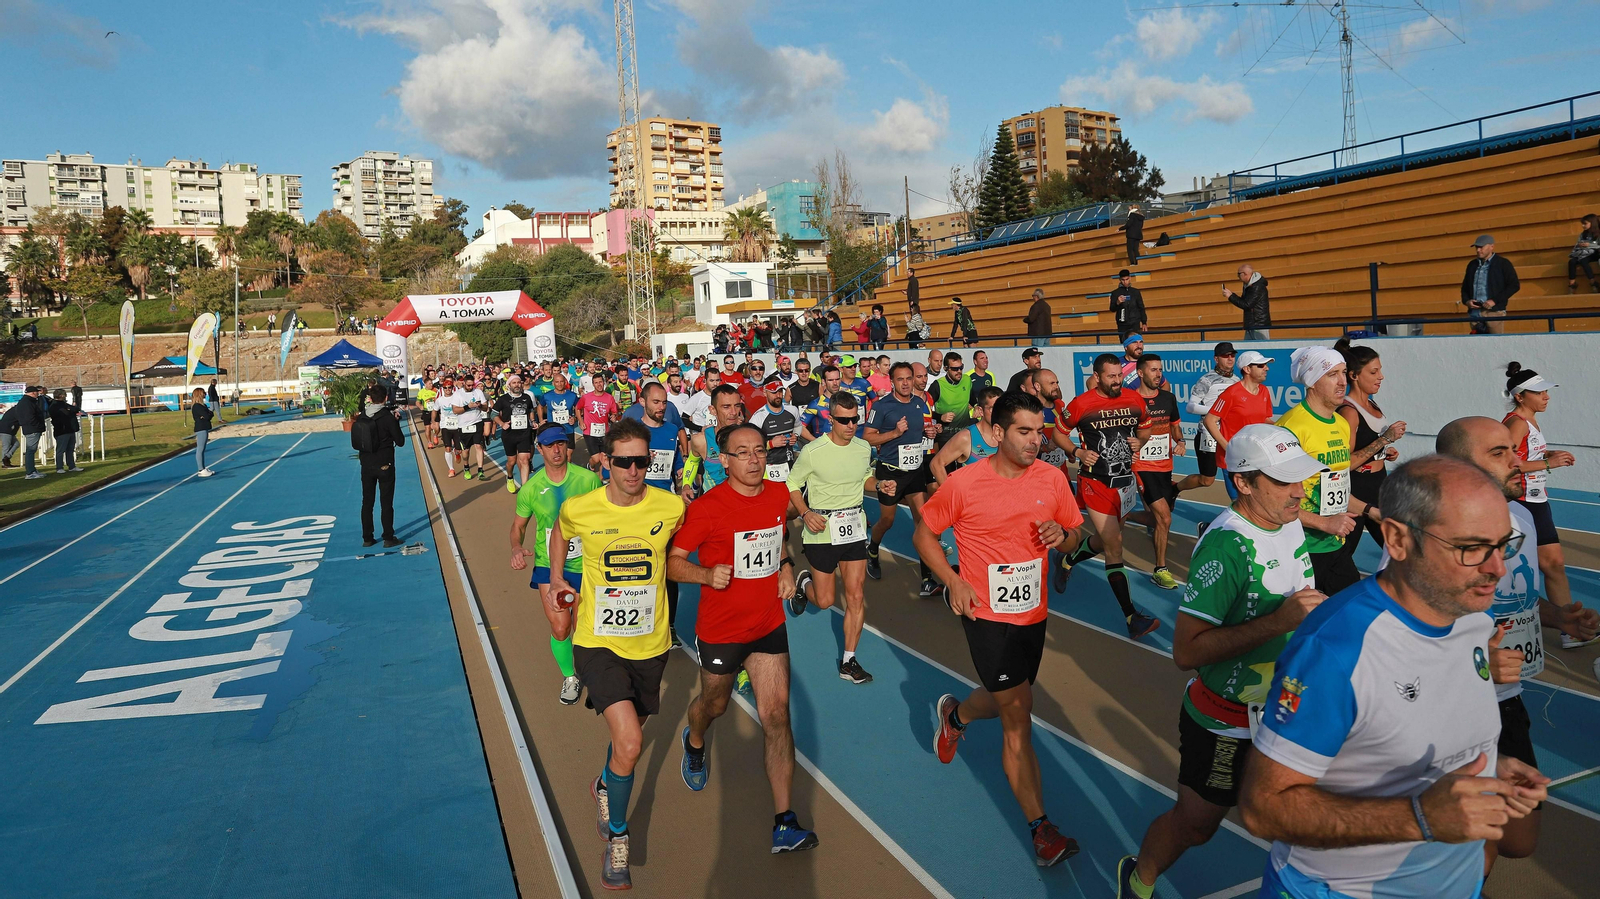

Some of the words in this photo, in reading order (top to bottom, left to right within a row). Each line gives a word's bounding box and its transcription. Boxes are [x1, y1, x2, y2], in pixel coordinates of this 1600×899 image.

[438, 296, 494, 307] TOYOTA
[439, 310, 450, 319] A.
[452, 308, 495, 318] TOMAX
[1098, 407, 1131, 419] TEAM
[1090, 417, 1138, 430] VIKINGOS
[1327, 439, 1344, 448] RUNNERS
[1144, 446, 1163, 456] 123
[902, 455, 919, 465] 285
[769, 470, 780, 478] 63
[1327, 488, 1347, 506] 331
[760, 530, 778, 538] Vopak
[838, 524, 853, 537] 98
[751, 540, 776, 549] AURELIO
[611, 555, 646, 563] STOCKHOLM
[742, 549, 771, 569] 141
[1301, 556, 1311, 568] TR
[1016, 563, 1036, 573] Vopak
[1006, 573, 1033, 583] ALVARO
[623, 589, 648, 597] Vopak
[996, 584, 1031, 603] 248
[33, 515, 337, 725] ALGECIRAS
[602, 608, 640, 626] 282
